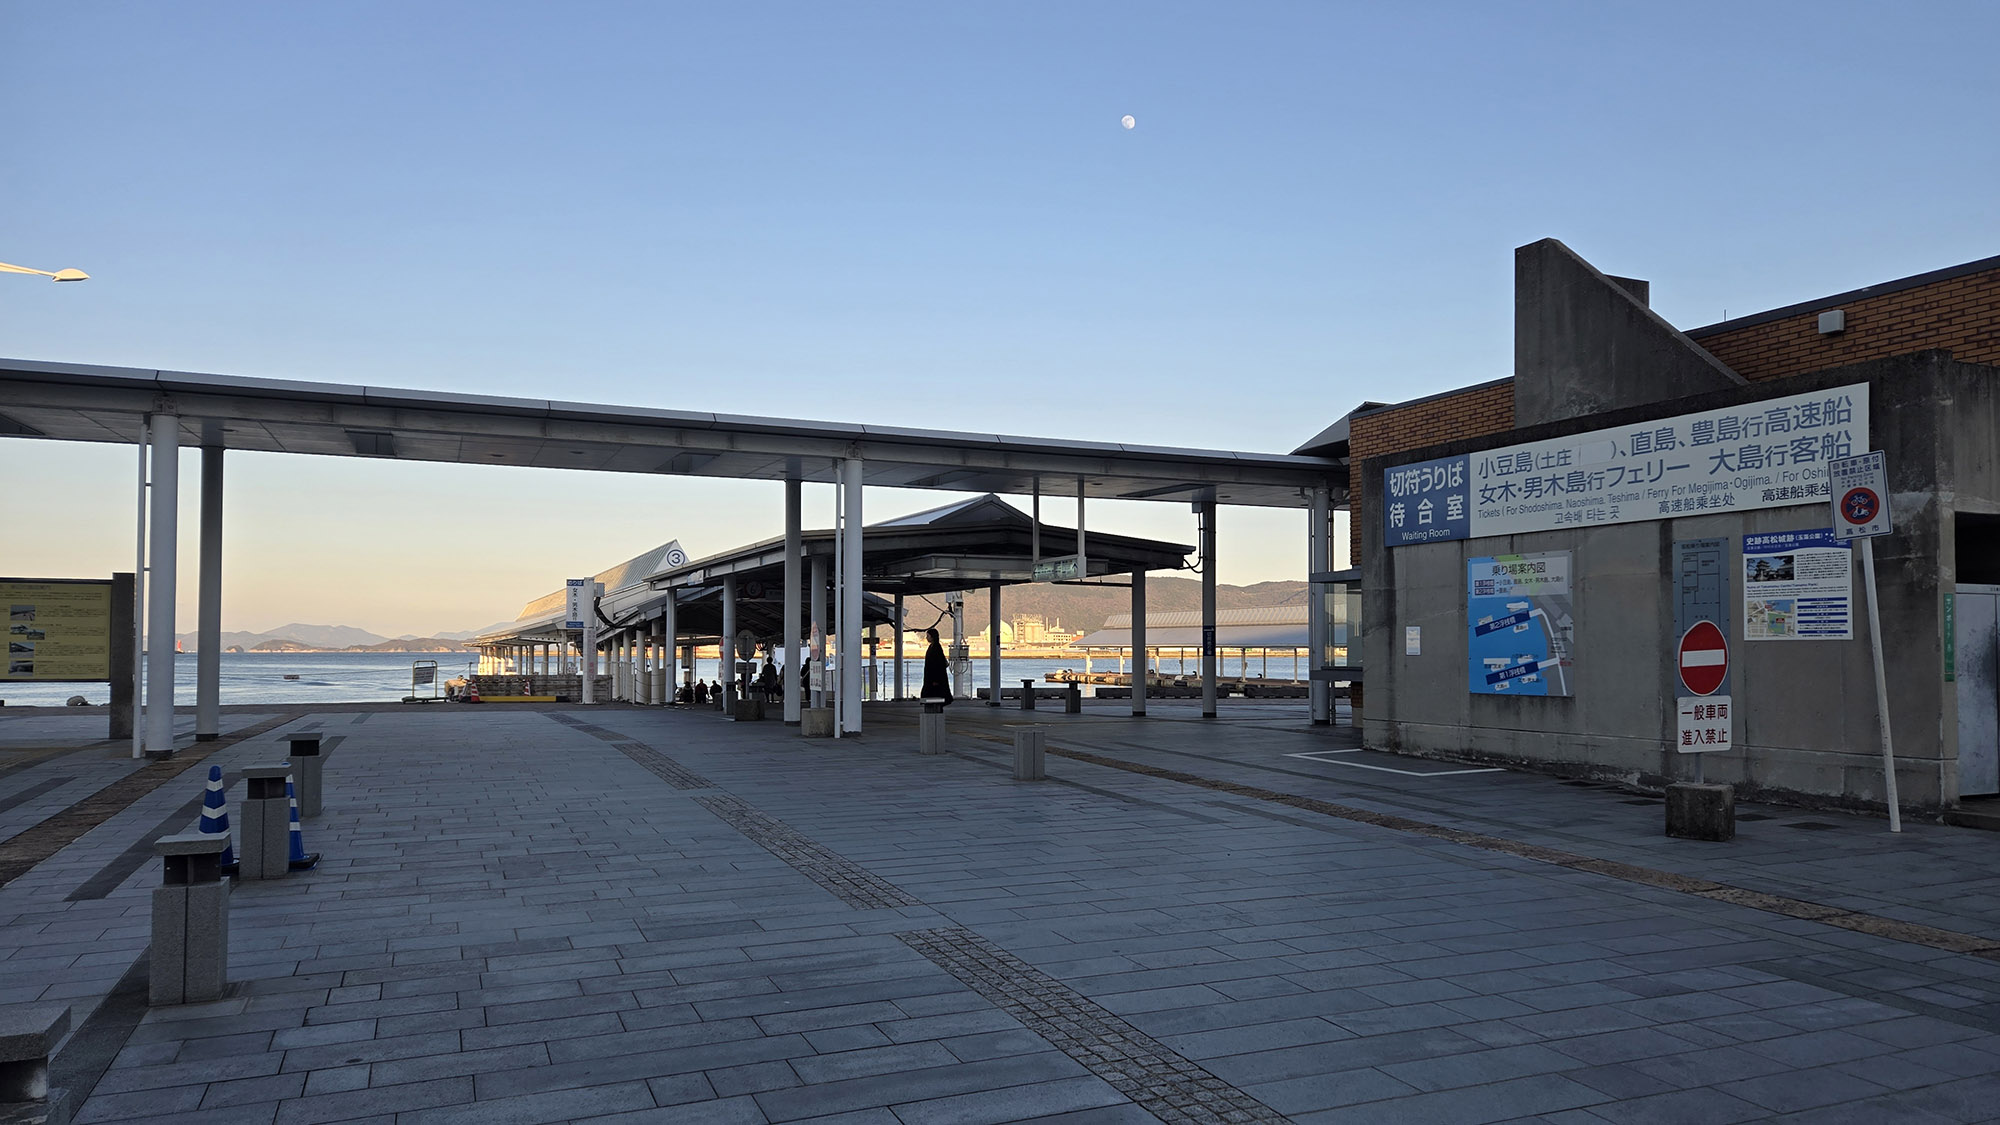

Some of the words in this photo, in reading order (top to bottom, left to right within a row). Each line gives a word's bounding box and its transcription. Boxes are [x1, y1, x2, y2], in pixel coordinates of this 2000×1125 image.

[1479, 457, 1690, 506] 女木・男木島行フェリー
[1708, 430, 1853, 475] 大島行客船
[1389, 459, 1464, 498] 切符うりば
[1478, 508, 1500, 519] Tickets
[1506, 505, 1518, 516] For
[1607, 491, 1640, 504] Teshima
[1647, 488, 1669, 500] Ferry
[1671, 485, 1686, 496] For
[1783, 470, 1800, 482] For
[1389, 494, 1464, 529] 待合室
[1554, 510, 1583, 524] 고속배
[1587, 508, 1606, 521] 타는
[1609, 505, 1620, 519] 곳
[1402, 530, 1427, 541] Waiting
[1429, 528, 1450, 539] Room
[1491, 561, 1546, 576] 乗り場案内図
[1681, 704, 1728, 720] 一般車両
[1681, 728, 1728, 746] 進入禁止
